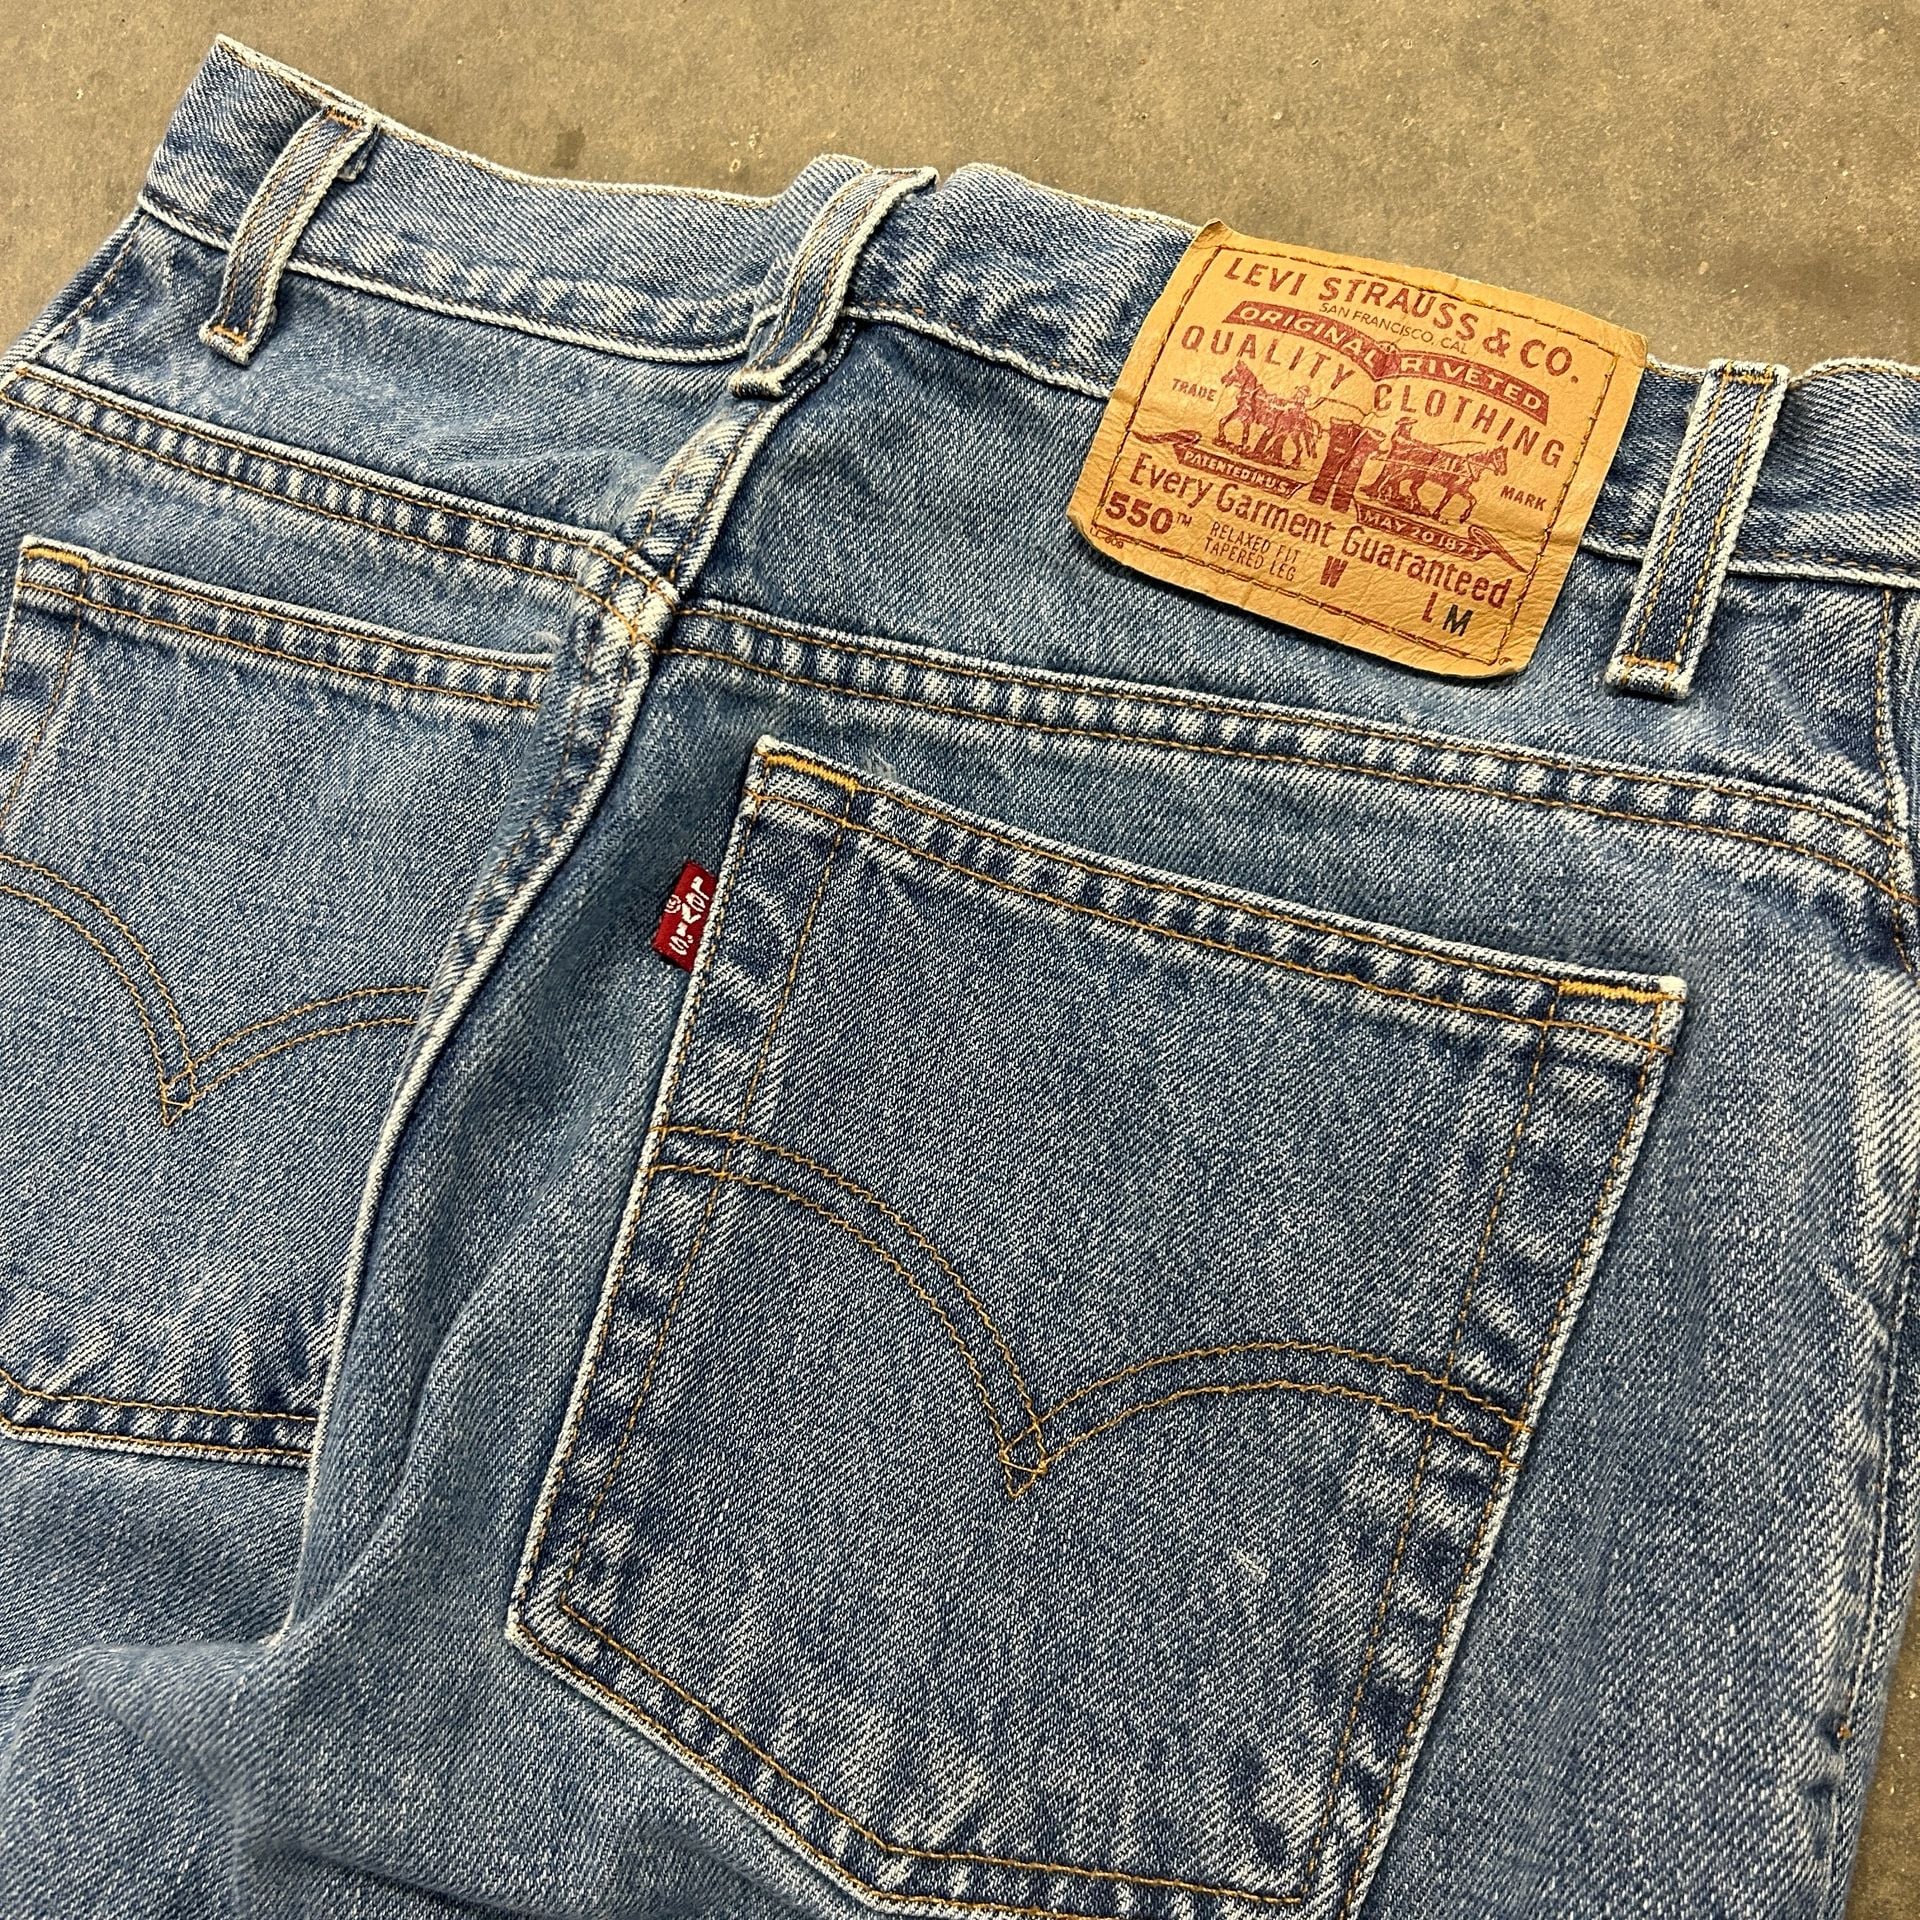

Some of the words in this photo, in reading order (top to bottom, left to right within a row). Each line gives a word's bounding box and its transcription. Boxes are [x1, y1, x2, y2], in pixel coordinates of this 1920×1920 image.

[1224, 257, 1307, 296] LEVI
[1318, 277, 1479, 341] STRAUSS
[1482, 327, 1511, 358] &
[1520, 339, 1579, 384] CO.
[1319, 302, 1350, 318] SAN
[1352, 310, 1435, 346] FRANCISCO,
[1440, 337, 1467, 355] CAL
[1239, 307, 1377, 369] ORIGINAL
[1400, 357, 1541, 410] RIVETED
[1172, 378, 1217, 401] TRADE
[1181, 325, 1355, 390] QUALITY
[1374, 383, 1565, 468] CLOTHING
[1184, 451, 1252, 481] PATENTED
[1500, 485, 1547, 511] MARK
[1129, 453, 1213, 509] Every
[1216, 483, 1337, 548] Garment
[1342, 525, 1512, 609] Guaranteed
[1210, 521, 1271, 554] RELAXED
[1276, 545, 1301, 563] FIT
[1363, 510, 1408, 532] MAY
[1411, 527, 1436, 542] 20
[1203, 537, 1264, 570] TAPERED
[1269, 562, 1296, 581] LEG
[1319, 556, 1349, 588] W
[1442, 604, 1474, 637] M
